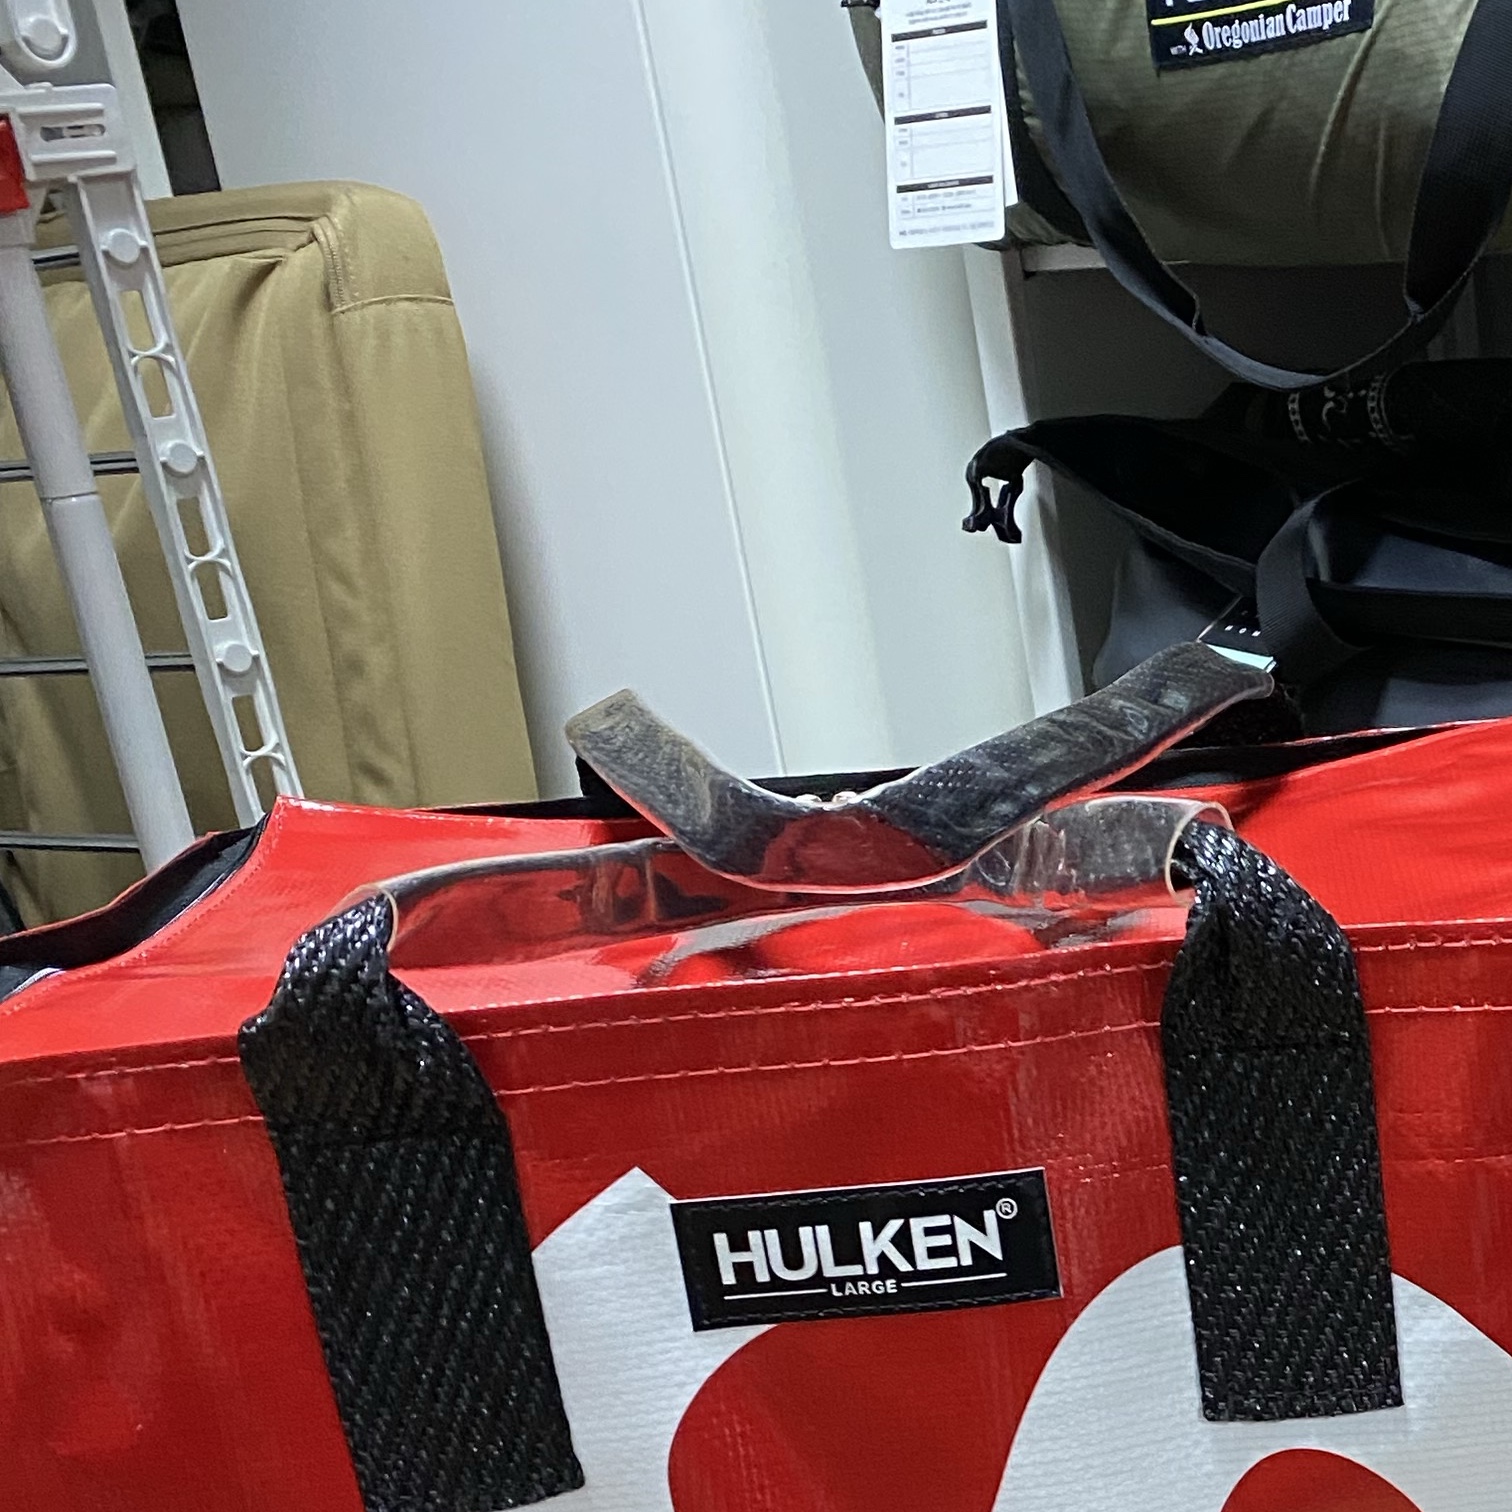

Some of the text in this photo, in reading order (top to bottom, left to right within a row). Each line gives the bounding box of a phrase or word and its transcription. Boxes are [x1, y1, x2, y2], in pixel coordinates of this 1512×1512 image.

[1202, 14, 1286, 50] Oregonian
[1286, 0, 1351, 33] Camper
[830, 1279, 897, 1297] LARGE
